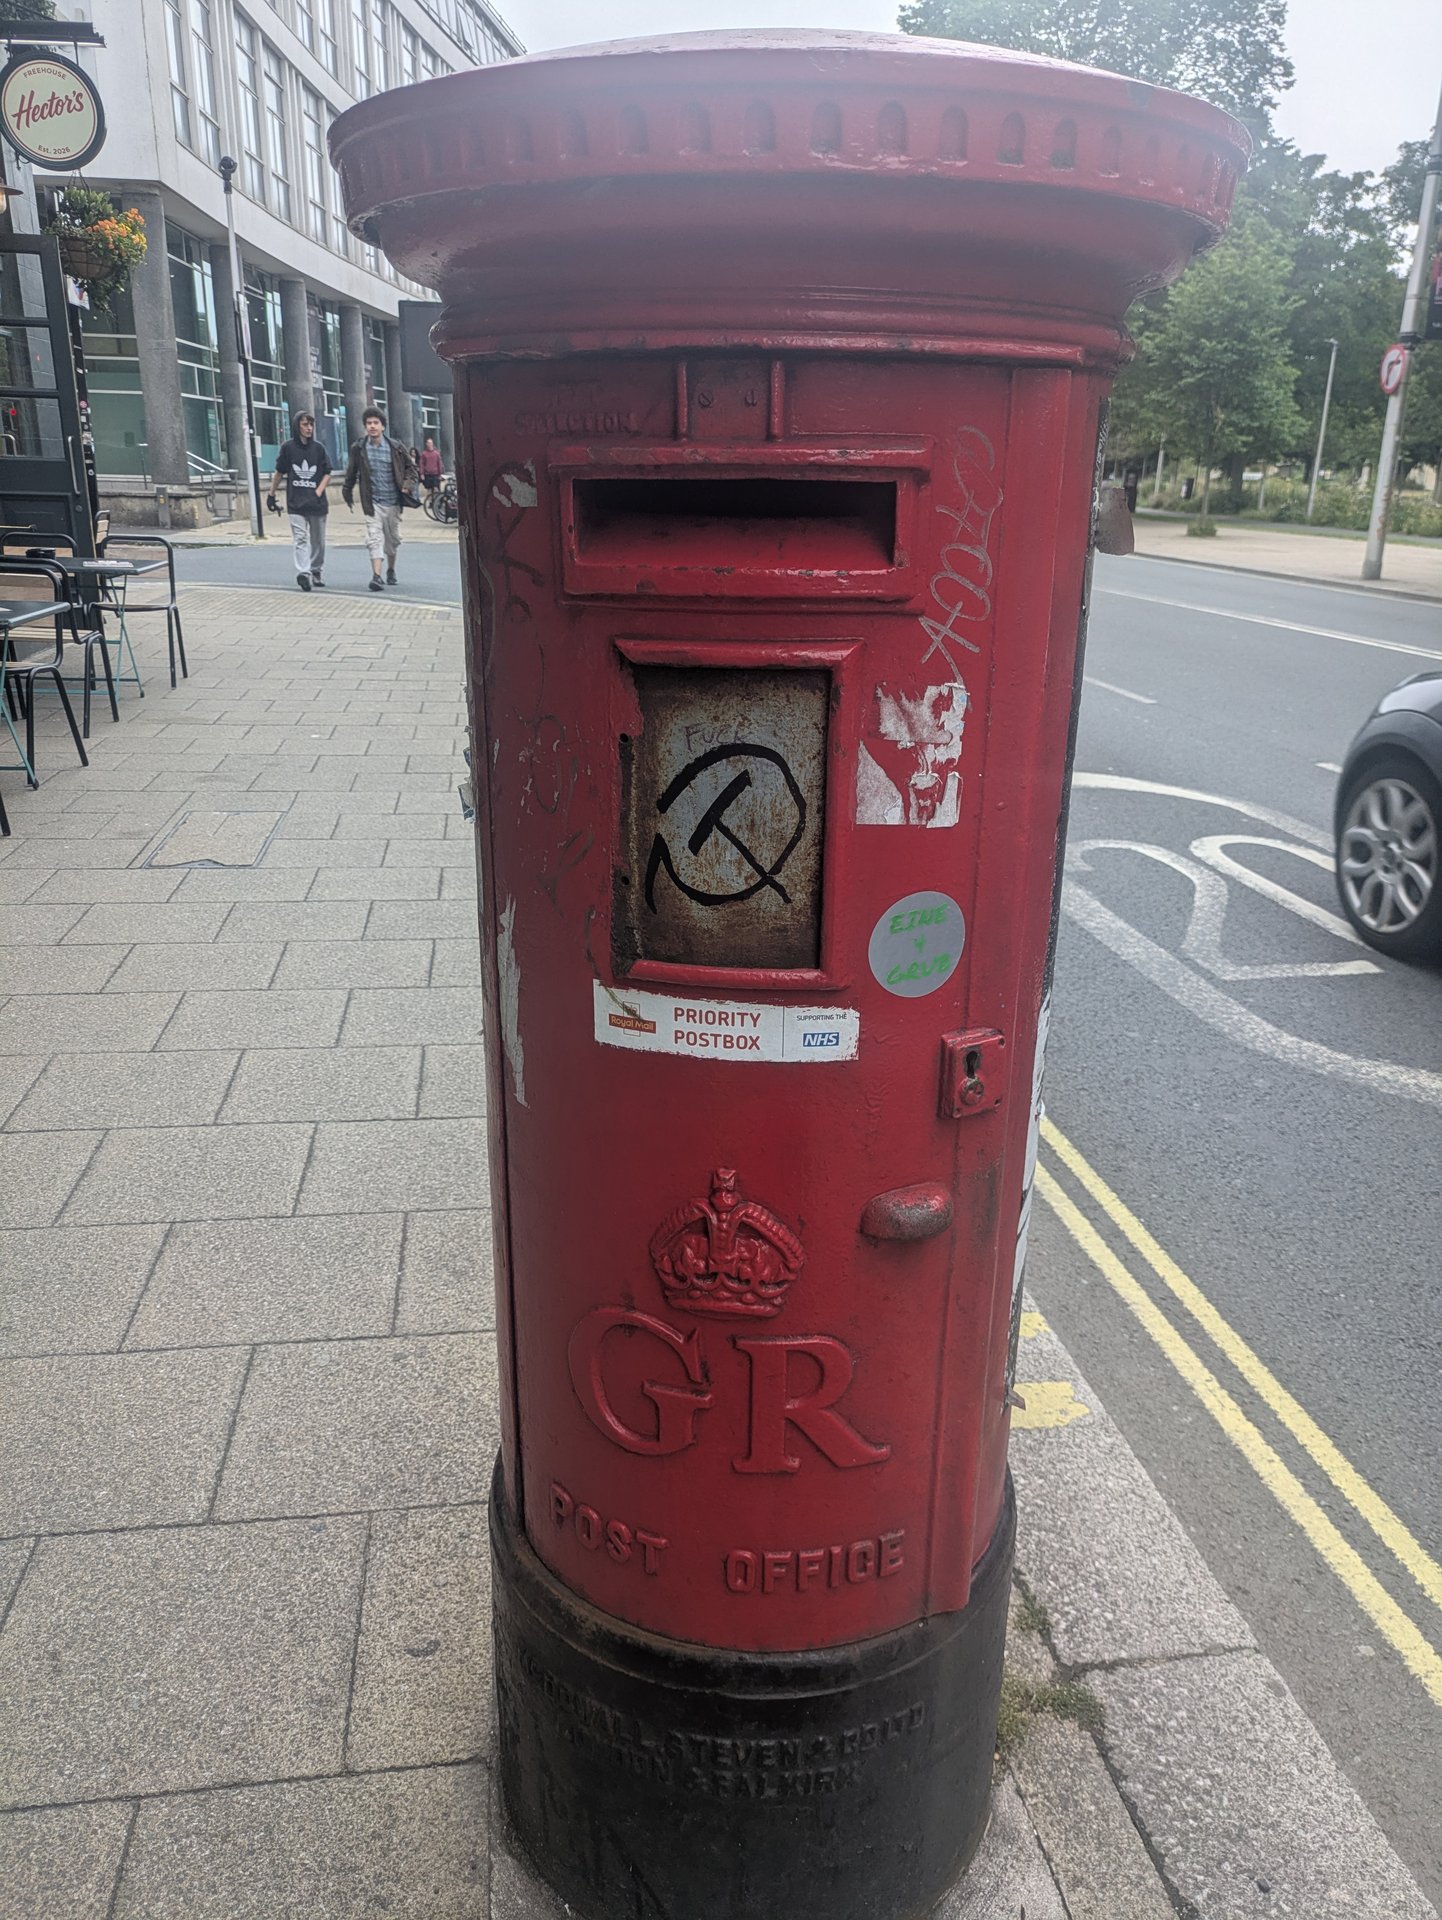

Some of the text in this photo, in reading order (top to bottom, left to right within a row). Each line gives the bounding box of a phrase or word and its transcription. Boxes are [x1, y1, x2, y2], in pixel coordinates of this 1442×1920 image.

[23, 67, 67, 81] FREEHOUSE
[11, 89, 84, 131] Hector's
[37, 145, 71, 155] Est. 2026
[292, 480, 317, 488] adidas
[685, 721, 750, 752] FUCK
[611, 1015, 655, 1031] Royal Mail
[673, 1006, 762, 1028] PRIORITY
[673, 1029, 761, 1051] POSTBOX
[804, 1033, 838, 1046] NHS
[567, 1305, 892, 1474] GR
[551, 1481, 906, 1593] POST OFFICE
